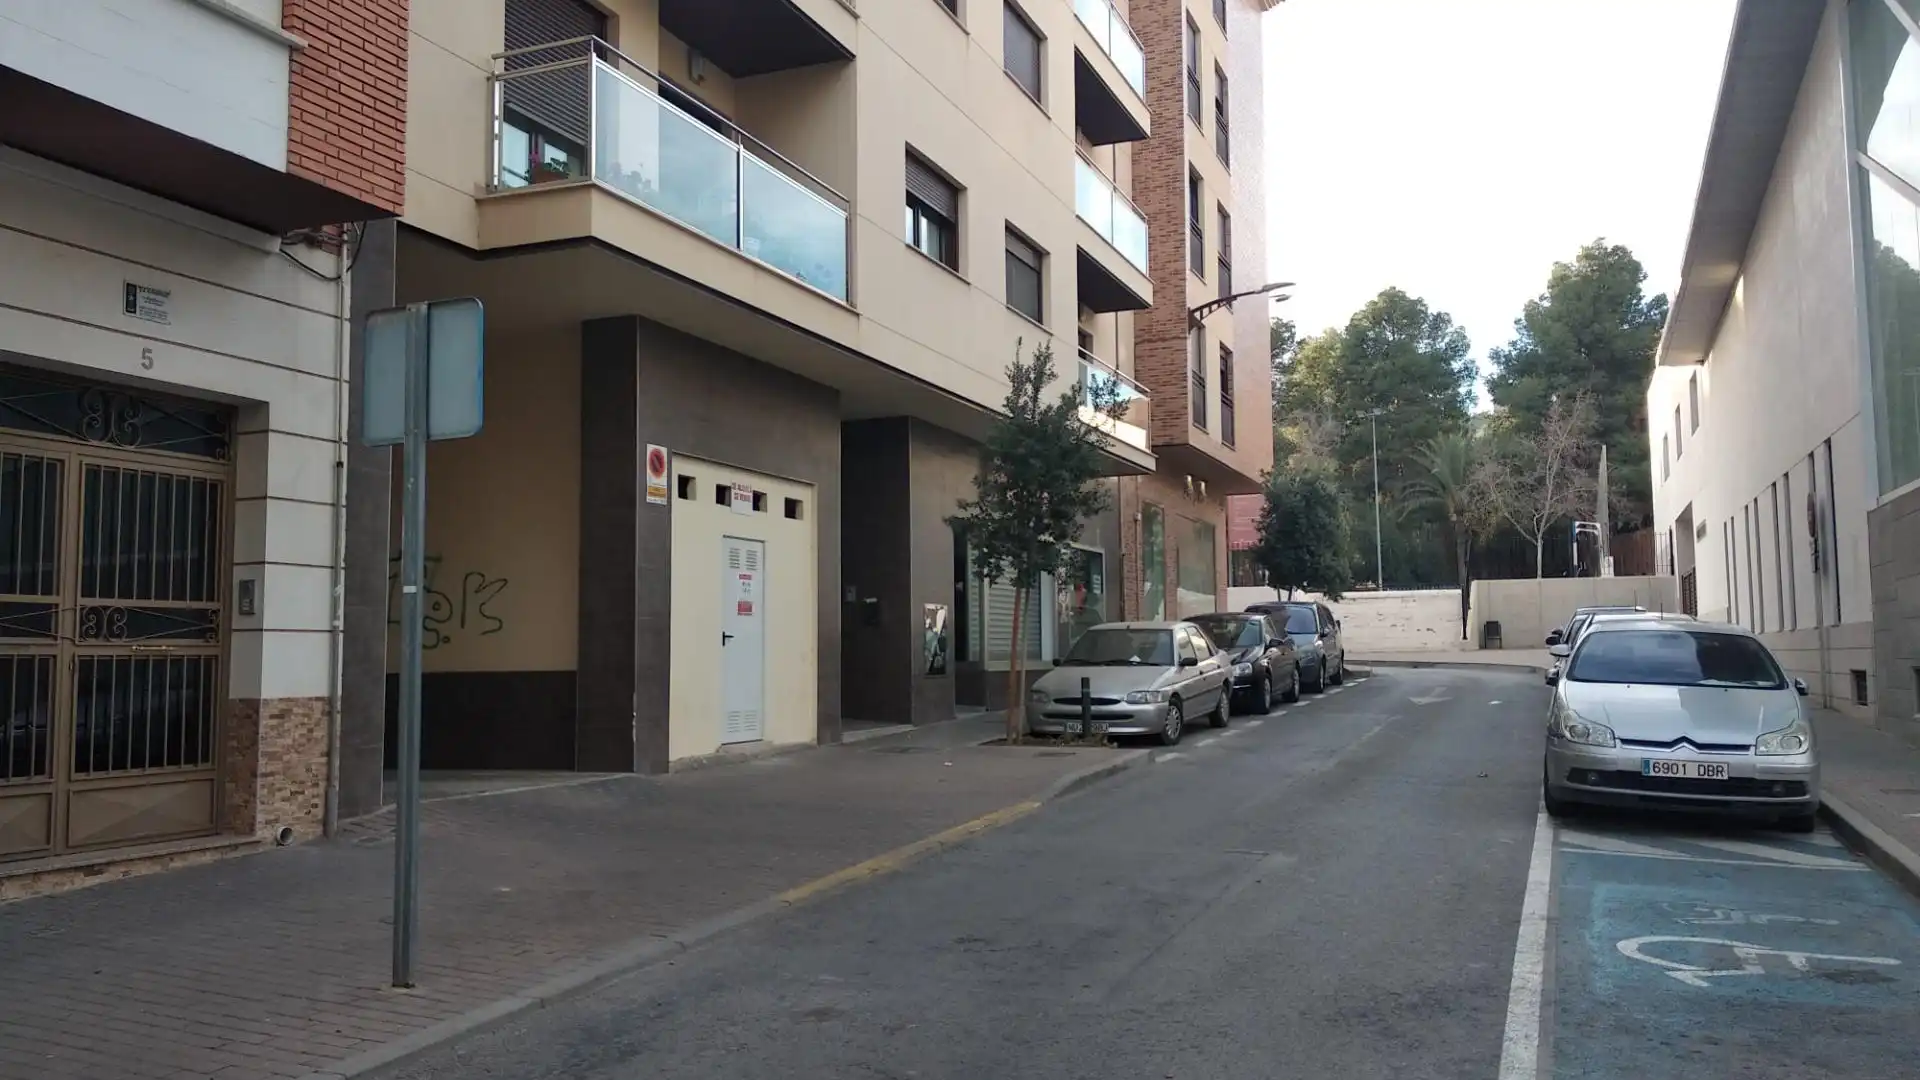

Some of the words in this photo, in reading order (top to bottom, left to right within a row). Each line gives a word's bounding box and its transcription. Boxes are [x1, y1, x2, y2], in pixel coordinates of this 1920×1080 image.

[141, 347, 154, 370] 5
[1652, 761, 1686, 775] 6901
[1697, 763, 1724, 777] DBR
